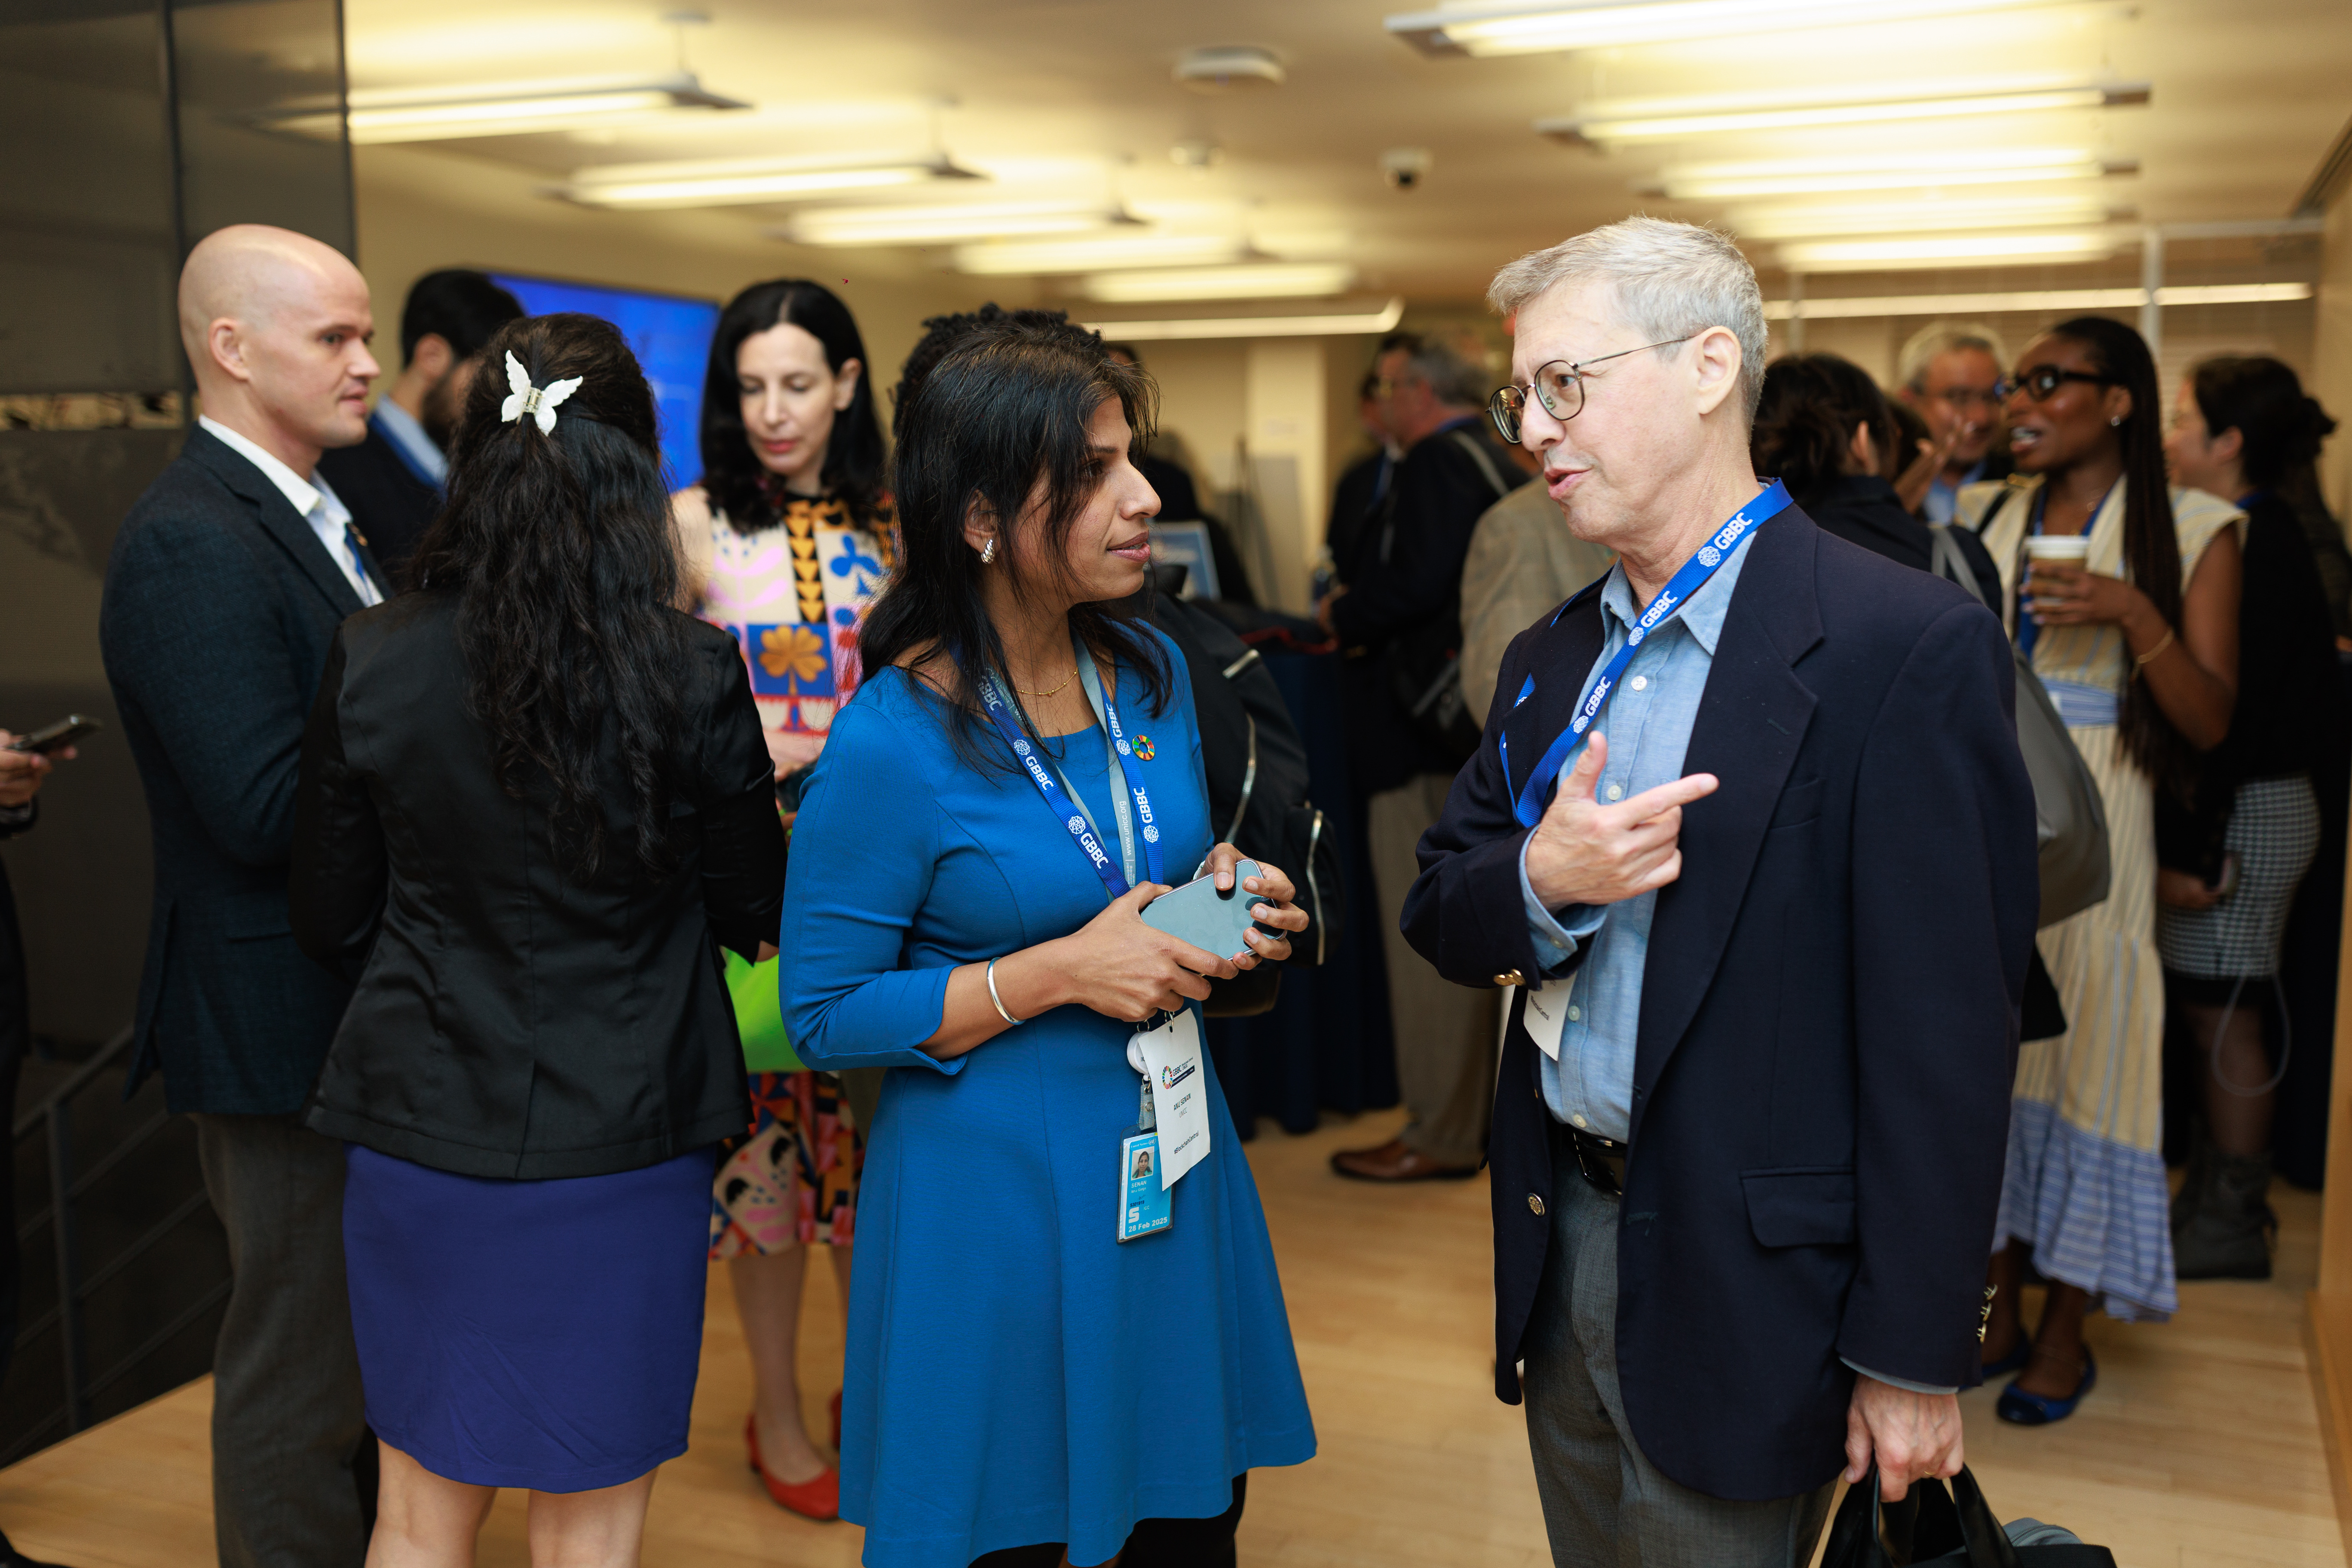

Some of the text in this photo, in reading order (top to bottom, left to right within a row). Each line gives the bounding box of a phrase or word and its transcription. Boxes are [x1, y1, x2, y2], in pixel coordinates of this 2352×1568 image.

[1713, 512, 1753, 550] GBBC
[1641, 590, 1678, 628] GBBC
[1585, 676, 1611, 717] GBBC
[1106, 703, 1122, 738] GBBC
[1026, 756, 1054, 790] GBBC
[1133, 787, 1153, 824] GBBC
[1119, 801, 1131, 856] www.unicc.org
[1080, 832, 1108, 869] GBBC
[1173, 1065, 1182, 1076] GBBC
[1180, 1093, 1191, 1106] SENAN
[1128, 1207, 1139, 1224] S
[1138, 1222, 1150, 1230] Feb
[1152, 1216, 1168, 1227] 2025
